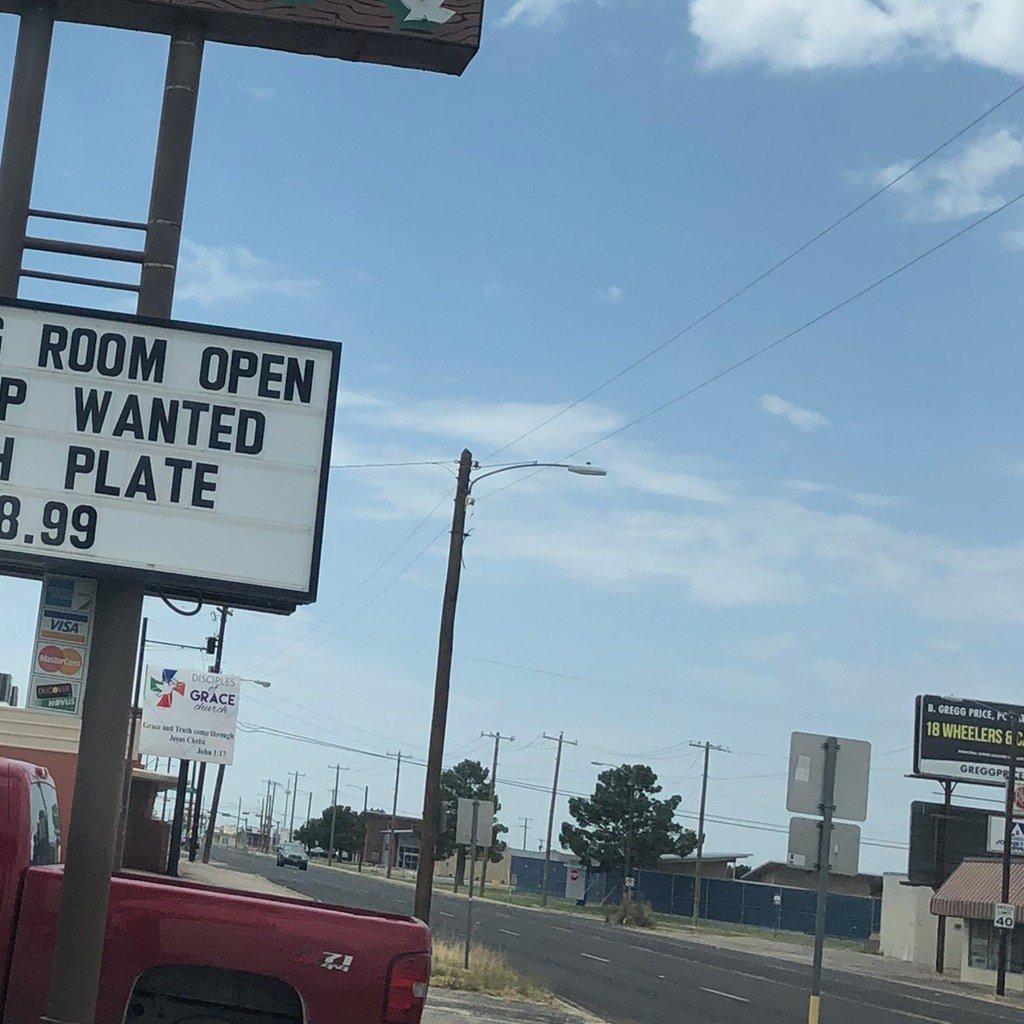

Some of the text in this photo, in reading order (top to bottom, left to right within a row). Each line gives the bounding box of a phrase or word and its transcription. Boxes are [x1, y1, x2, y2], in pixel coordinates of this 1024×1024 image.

[37, 323, 167, 384] ROOM
[198, 346, 315, 404] OPEN
[74, 386, 266, 455] WANTED
[64, 445, 219, 509] PLATE
[49, 618, 79, 634] VISA
[191, 673, 236, 688] DISCIPLES
[48, 697, 76, 707] NOVUS
[190, 689, 236, 706] GRACE
[194, 701, 228, 714] church
[938, 704, 967, 717] GREGG
[968, 708, 995, 721] PRICE,
[142, 721, 162, 731] Grace
[162, 723, 174, 732] and
[175, 725, 193, 734] Truth
[210, 730, 235, 741] through
[926, 721, 940, 737] 18
[942, 722, 1003, 744] WHEELERS
[169, 734, 206, 745] Jesus Christ
[197, 747, 212, 756] John
[995, 916, 1013, 927] 40
